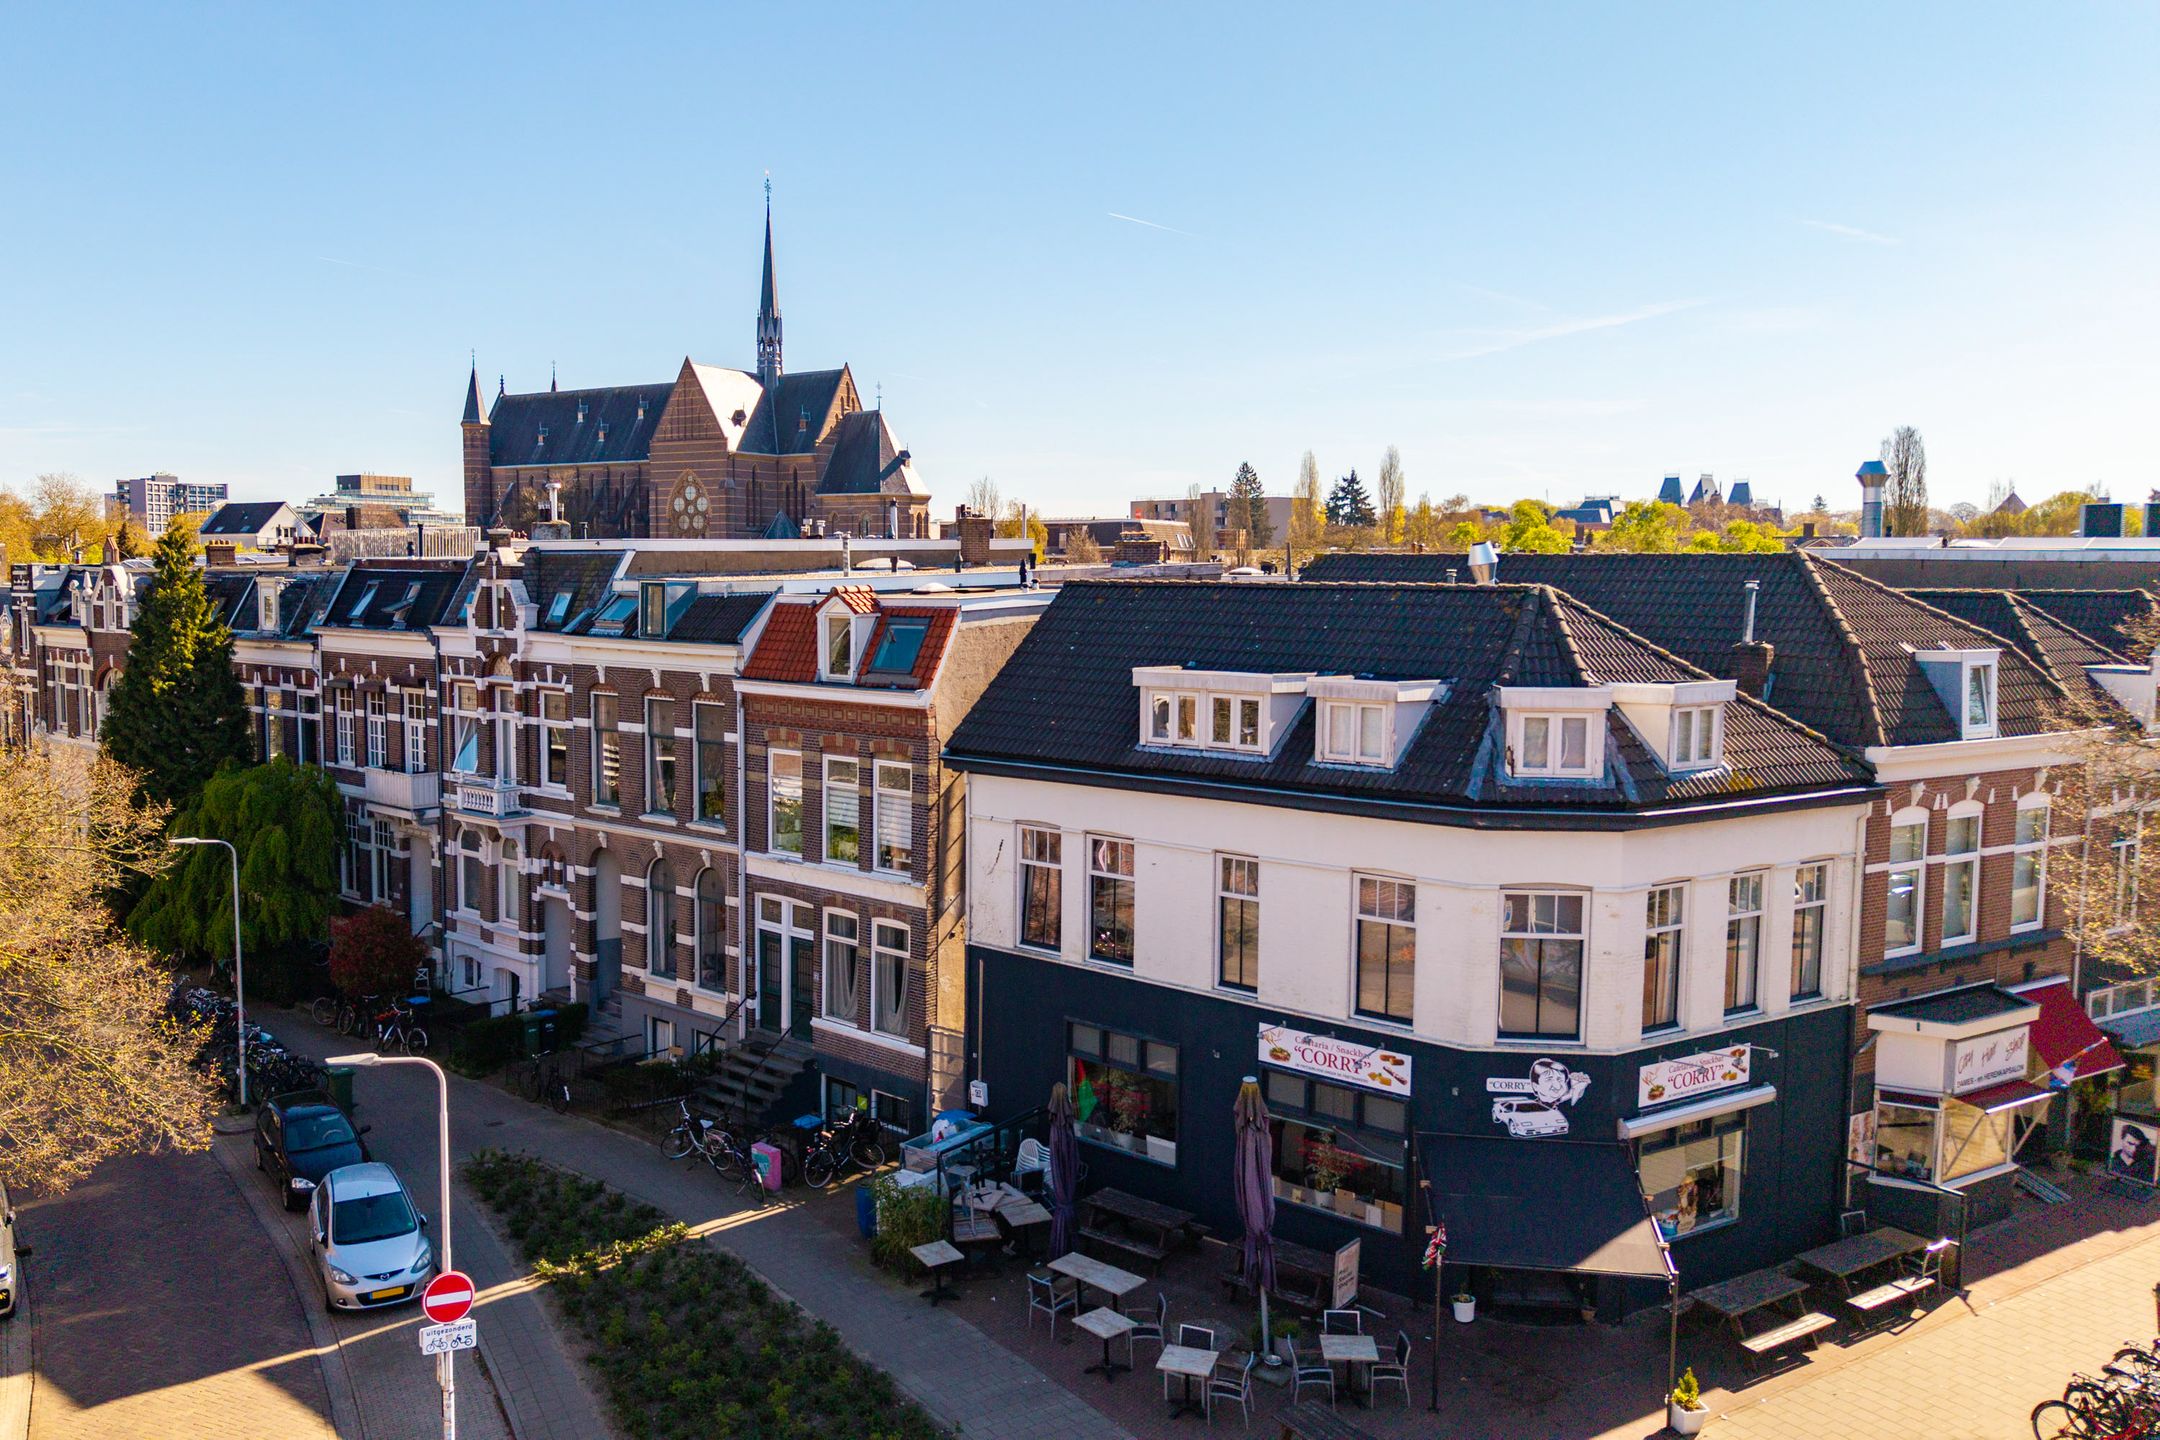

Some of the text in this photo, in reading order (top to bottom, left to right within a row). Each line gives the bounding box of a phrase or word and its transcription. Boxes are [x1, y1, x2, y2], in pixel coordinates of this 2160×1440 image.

[1294, 1036, 1329, 1050] Ctaria
[1336, 1045, 1370, 1059] Snackb
[426, 1324, 472, 1336] uitgezonderd
